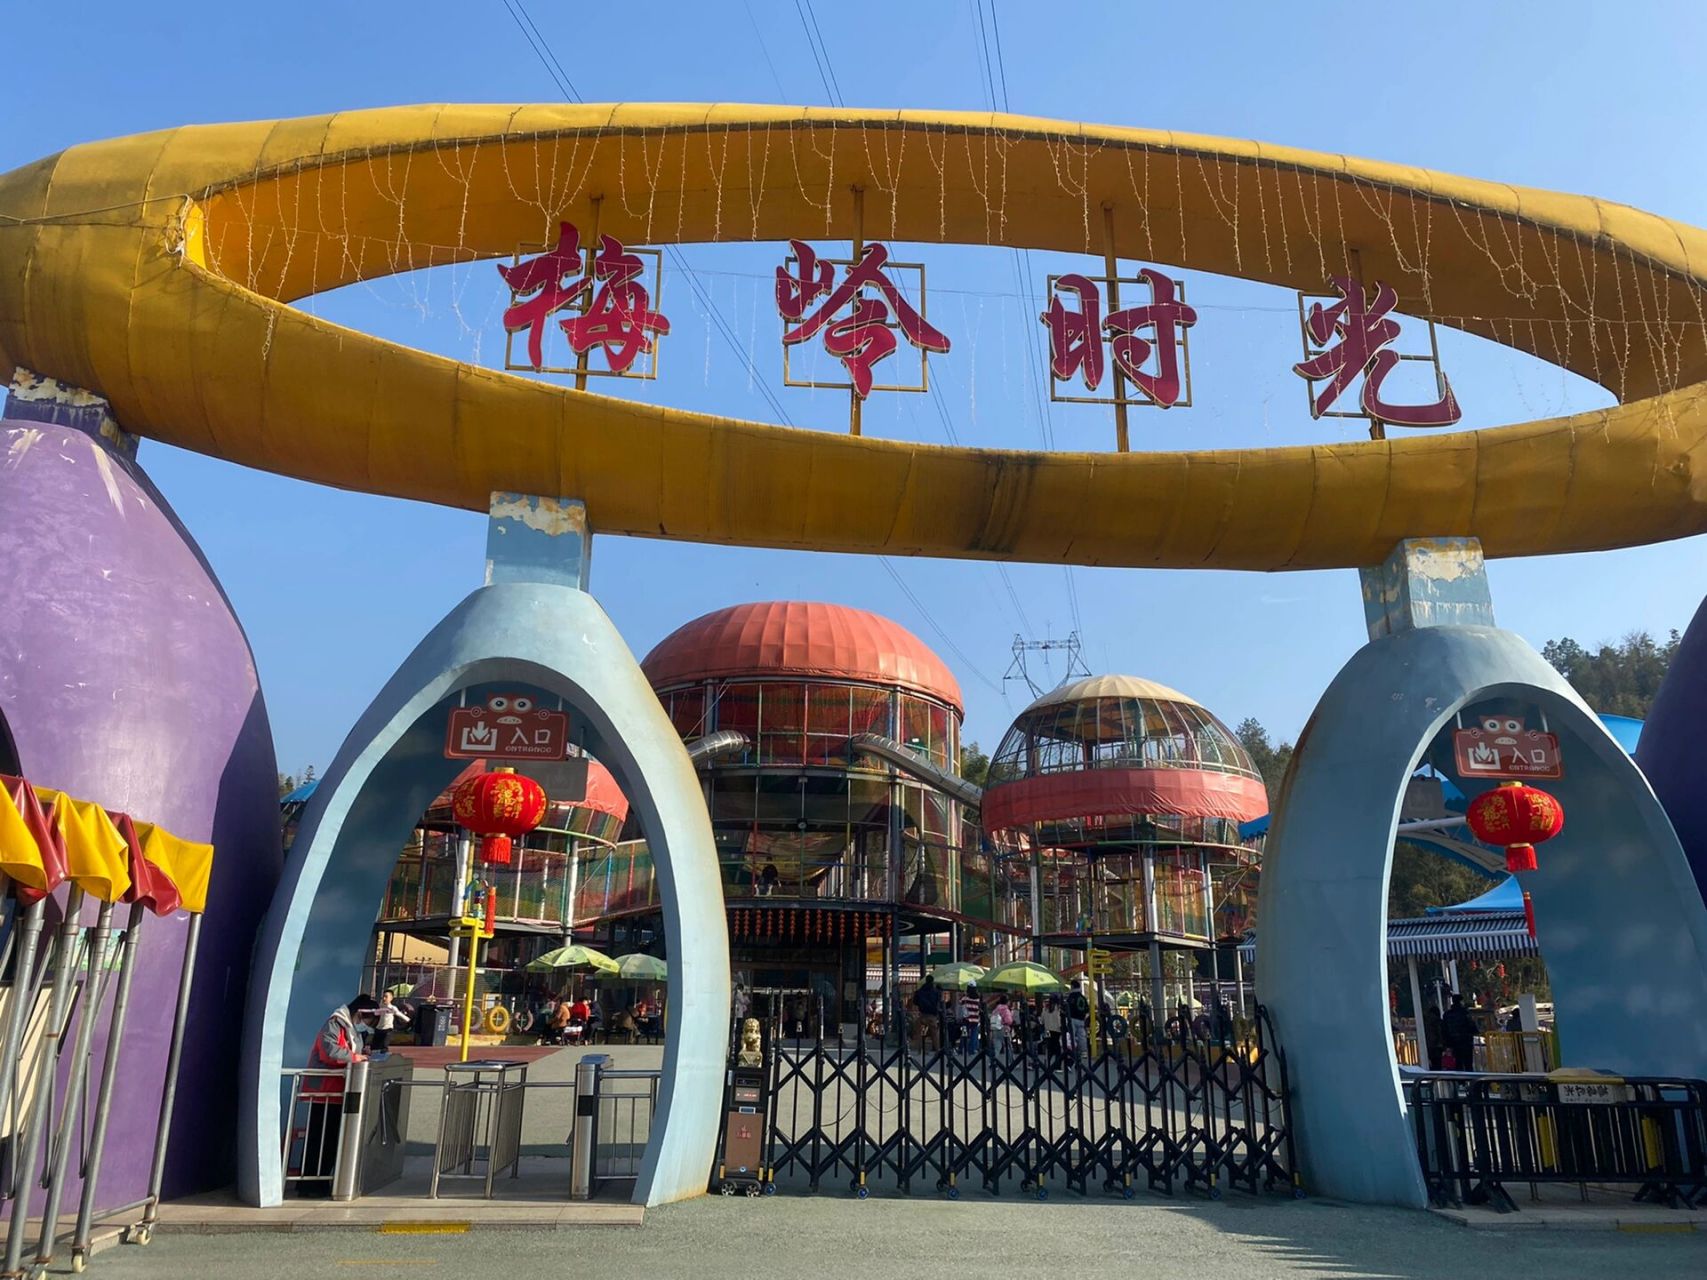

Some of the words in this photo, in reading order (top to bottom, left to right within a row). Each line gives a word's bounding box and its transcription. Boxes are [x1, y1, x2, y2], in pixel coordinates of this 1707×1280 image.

[497, 221, 1462, 426] 梅岭时光
[510, 727, 551, 745] 入口
[1512, 747, 1546, 764] 入口
